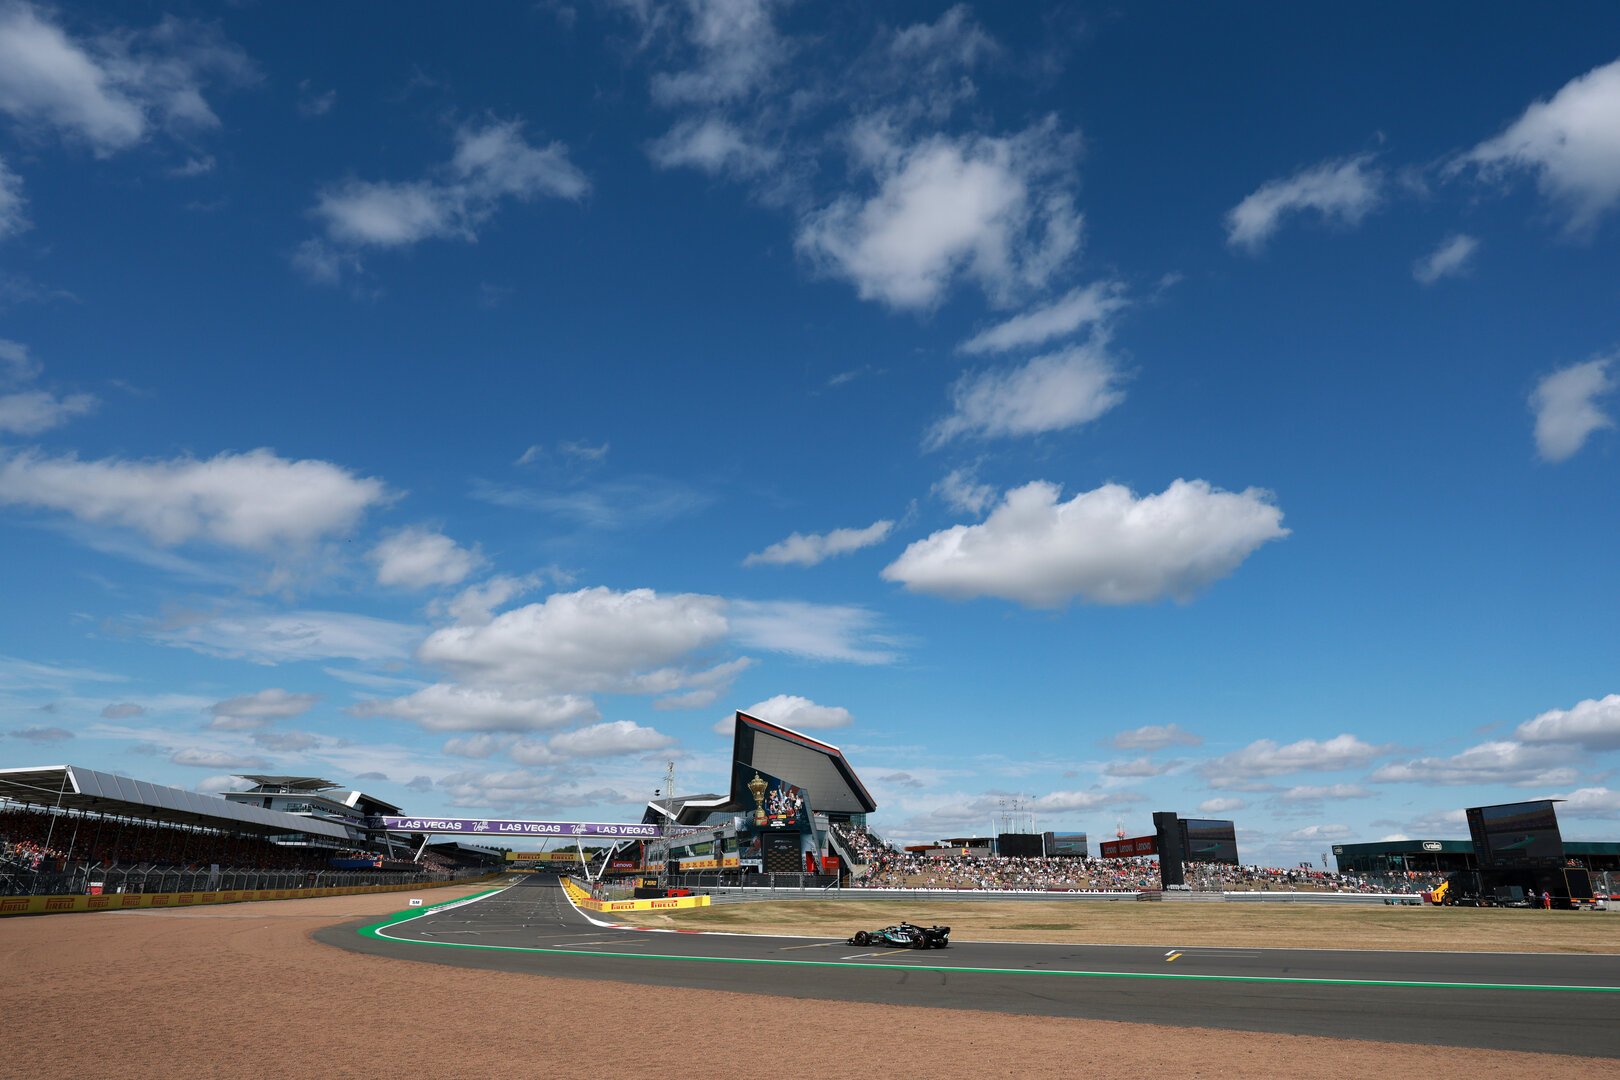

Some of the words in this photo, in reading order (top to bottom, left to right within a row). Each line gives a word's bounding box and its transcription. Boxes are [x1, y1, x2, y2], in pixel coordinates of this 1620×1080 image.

[397, 820, 421, 829] LAS
[423, 821, 462, 830] VEGAS
[499, 823, 522, 831] LAS
[523, 824, 561, 832] VEGAS
[596, 825, 617, 833] LAS
[619, 826, 655, 835] VEGAS
[1119, 844, 1133, 853] Lenovo
[1135, 841, 1151, 851] Lenovo
[0, 899, 30, 912] PIRELLI
[45, 897, 75, 910] PIRELLI
[88, 896, 110, 908] PIRELLI
[121, 895, 142, 906] PIRELLI
[650, 900, 678, 908] PIRELLI
[611, 902, 635, 910] PIRELLI
